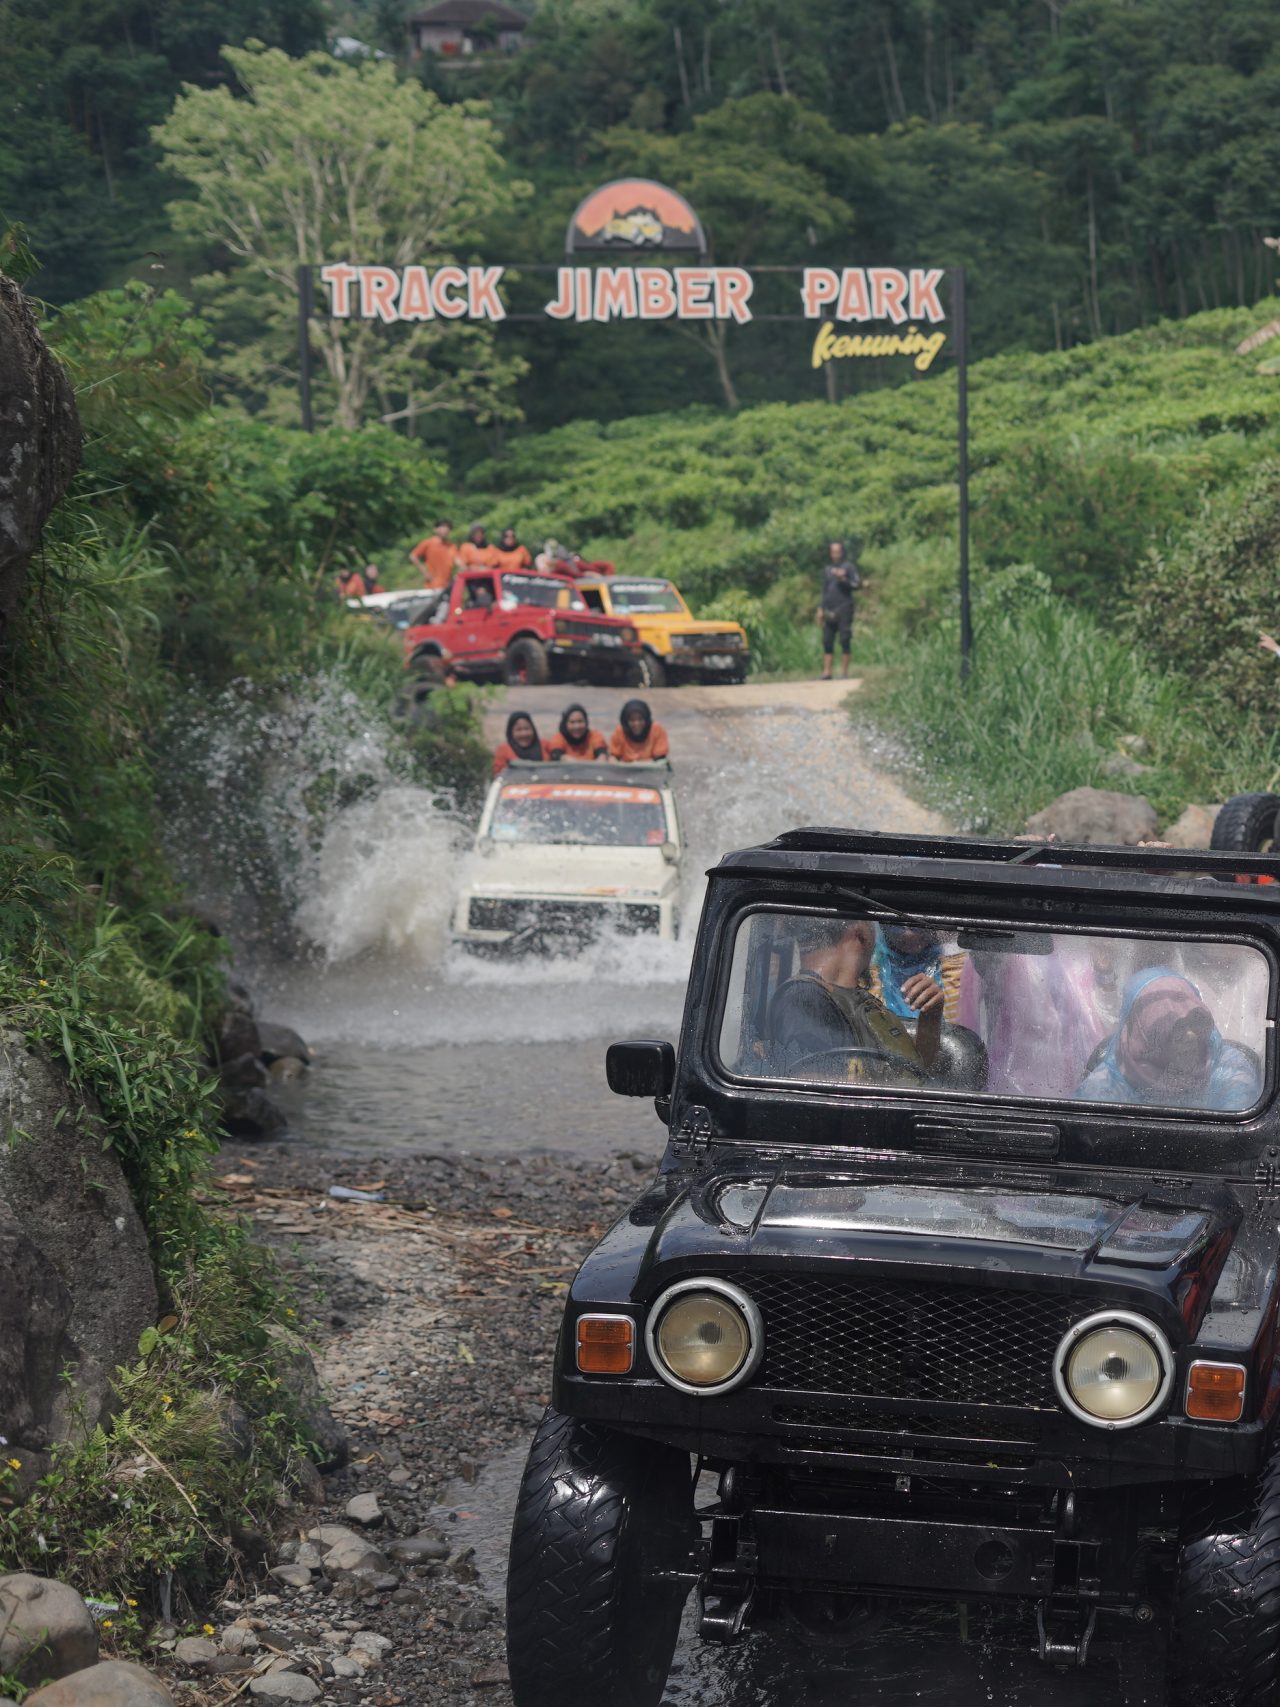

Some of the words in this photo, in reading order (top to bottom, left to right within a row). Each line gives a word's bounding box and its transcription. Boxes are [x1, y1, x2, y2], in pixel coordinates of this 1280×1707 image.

[321, 263, 506, 324] TRACK
[545, 267, 753, 324] JIMBER
[800, 267, 945, 324] PARK
